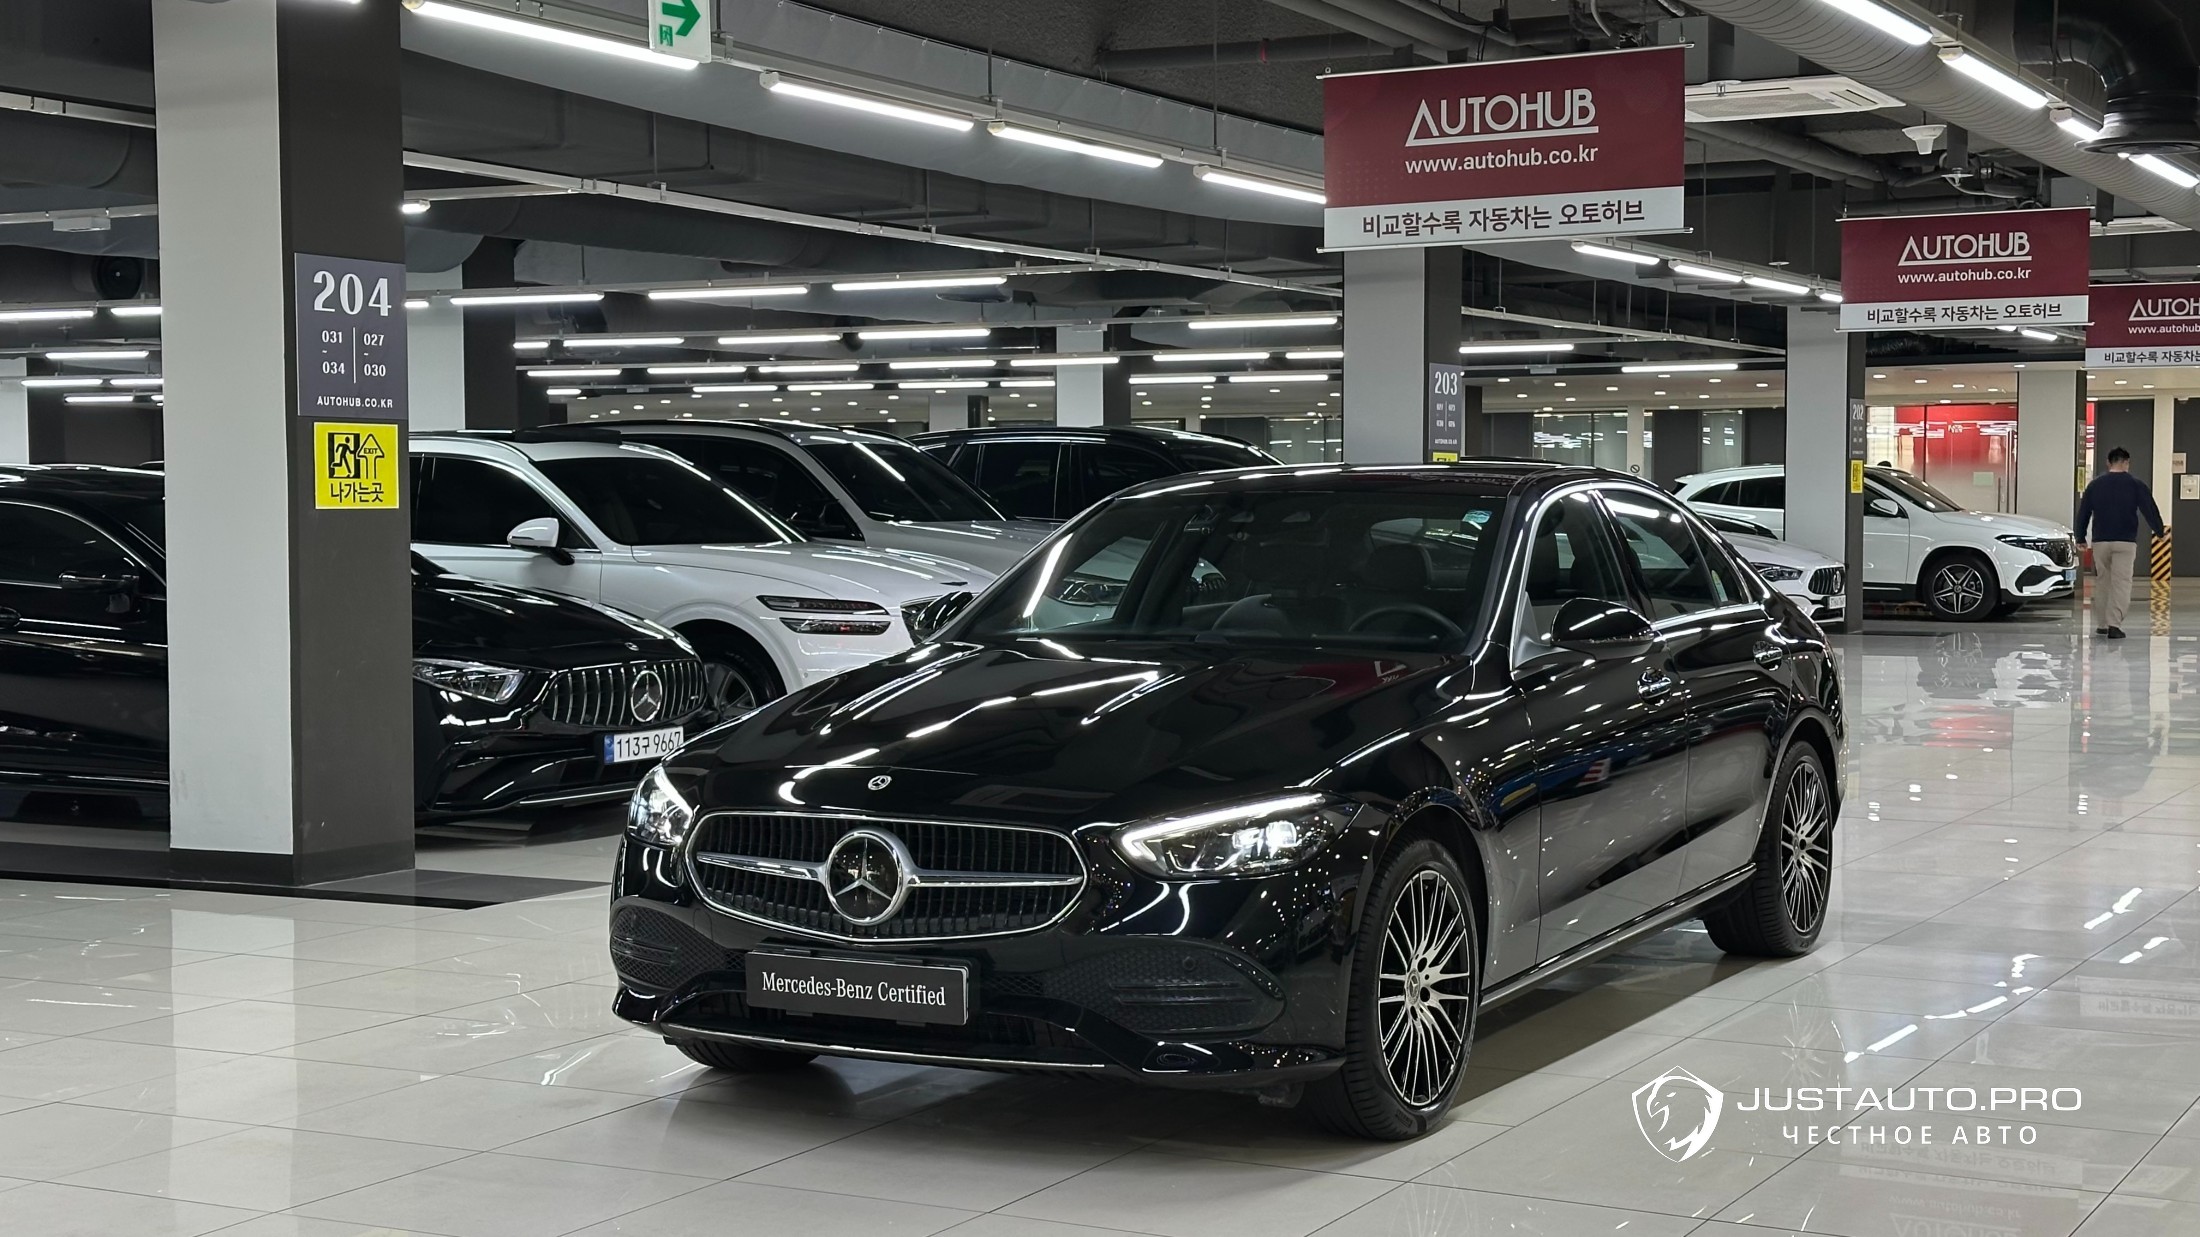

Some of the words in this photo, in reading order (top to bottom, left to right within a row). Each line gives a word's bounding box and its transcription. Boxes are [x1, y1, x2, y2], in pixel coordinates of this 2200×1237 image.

[1405, 87, 1599, 147] AUTOHUB
[1405, 143, 1599, 174] www.autohub.co.kr
[1362, 209, 1462, 239] 비교할수록
[1468, 204, 1553, 233] 자동차는
[1558, 199, 1646, 227] 오토허브
[1897, 231, 2033, 266] AUTOHUB
[1897, 266, 2032, 284] www.autohub.co.kr
[313, 270, 393, 317] 204
[1867, 306, 1937, 325] 비교할수록
[1941, 304, 1999, 323] 자동차는
[2002, 302, 2063, 319] 오토허브
[321, 329, 343, 344] 031
[363, 333, 385, 347] 027
[322, 361, 345, 375] 034
[363, 363, 387, 377] 030
[1434, 371, 1458, 396] 203
[316, 395, 393, 409] AUTOHUB.CO.KR
[1852, 403, 1864, 421] 202
[363, 447, 379, 455] EXIT
[330, 481, 385, 504] 나가는곳
[616, 736, 650, 759] 113구
[653, 731, 681, 753] 9667
[762, 971, 873, 1001] Mercedes-Benz
[877, 981, 946, 1006] Certified
